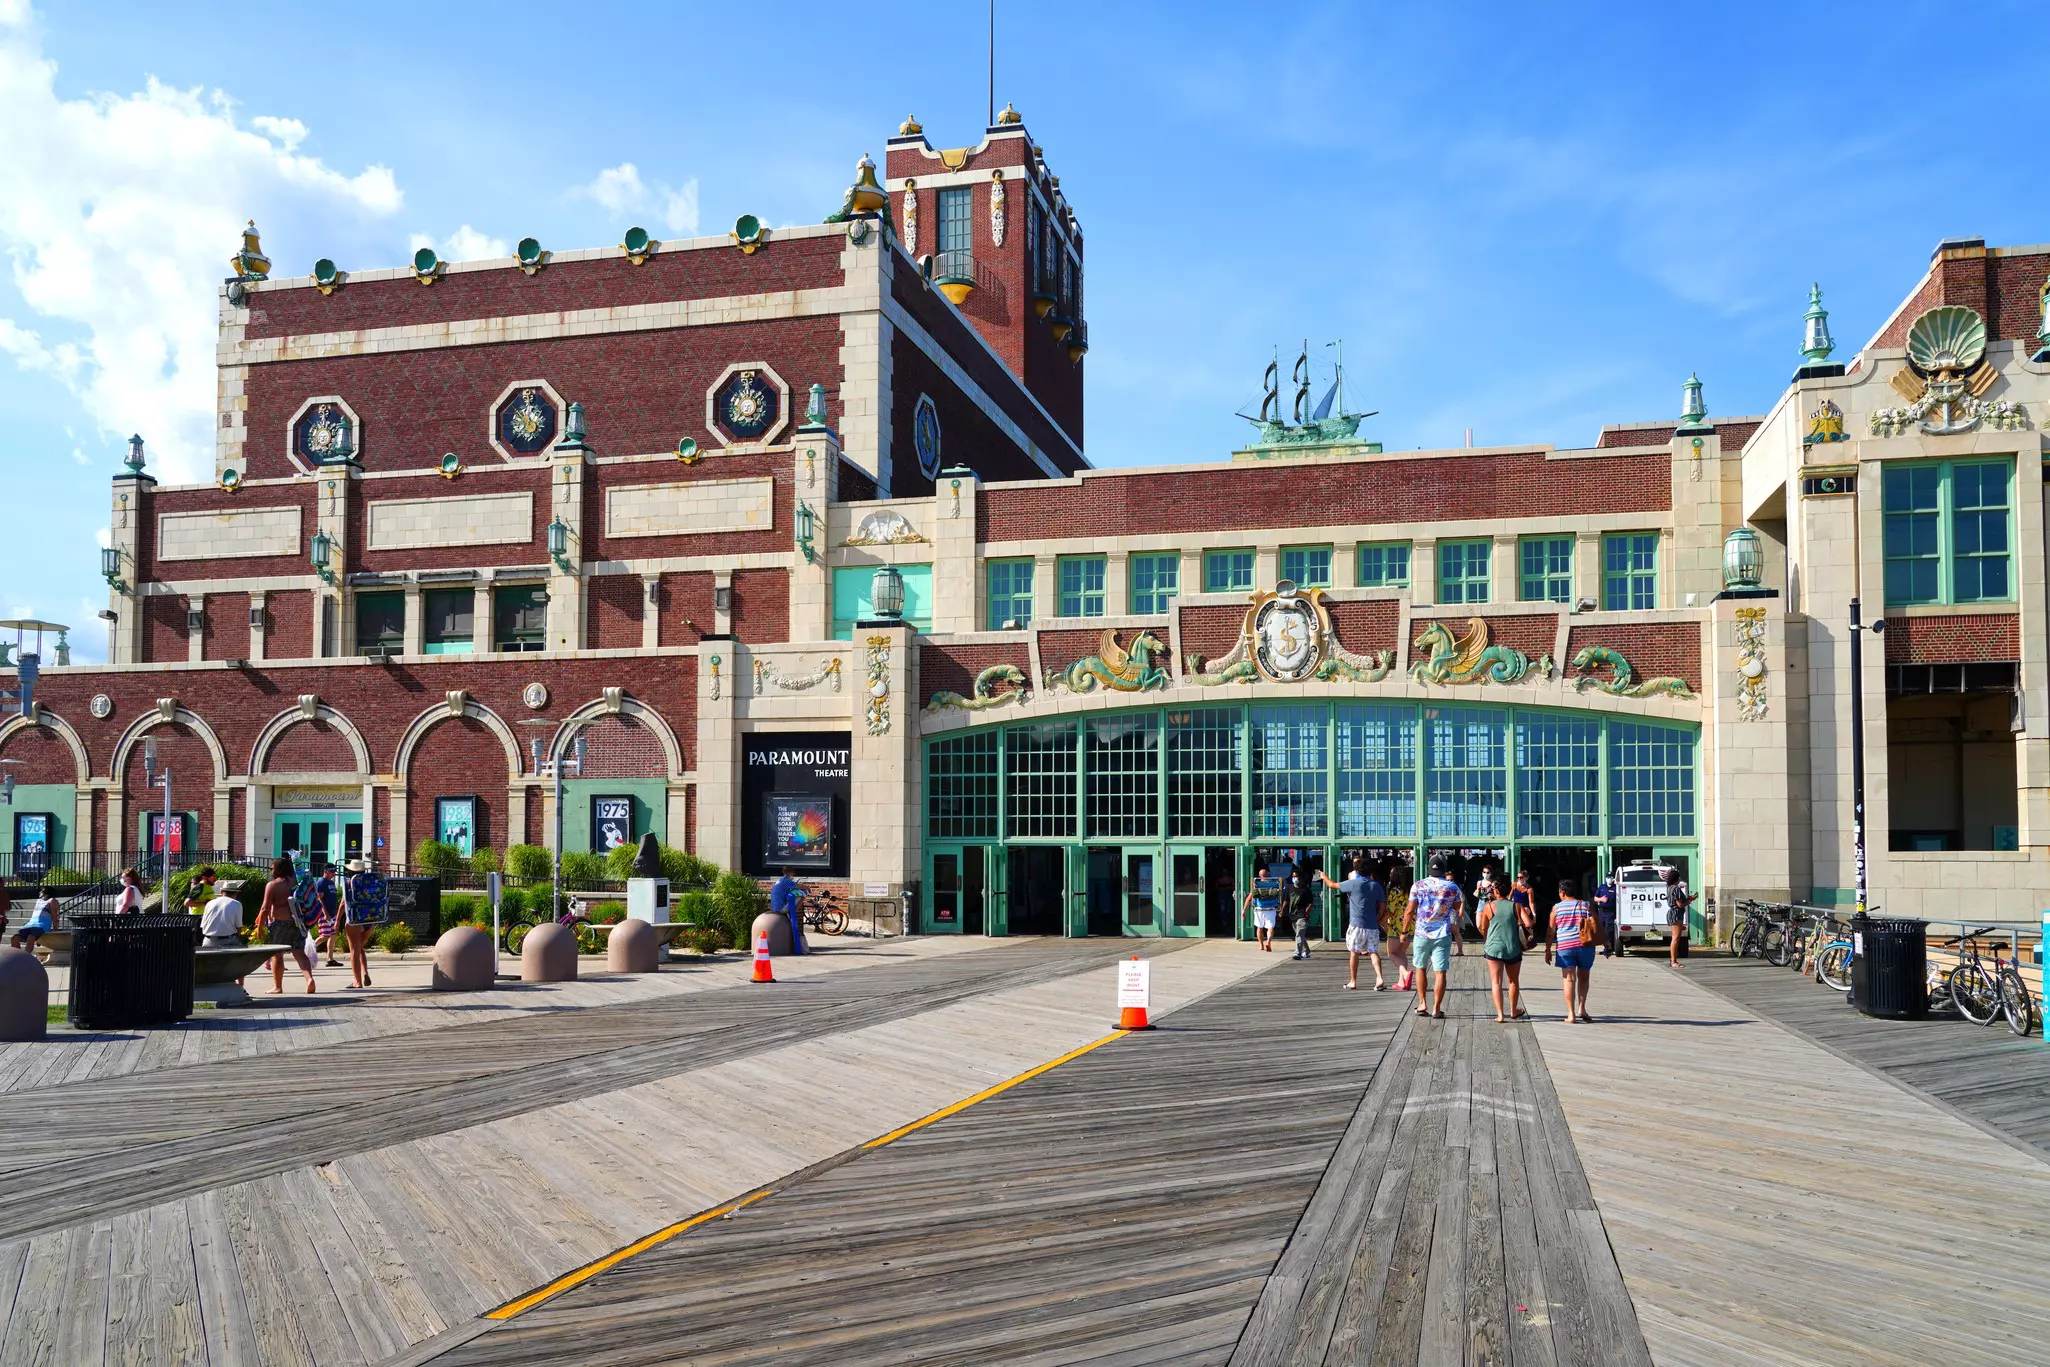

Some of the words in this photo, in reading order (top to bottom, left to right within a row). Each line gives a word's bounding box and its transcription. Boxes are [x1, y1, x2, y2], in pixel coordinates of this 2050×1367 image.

[749, 750, 849, 765] PARAMOUNT
[814, 769, 849, 777] THEATRE
[281, 790, 361, 803] Paramount
[443, 806, 472, 820] 1982
[597, 803, 628, 817] 1975
[1631, 893, 1667, 901] POLIC
